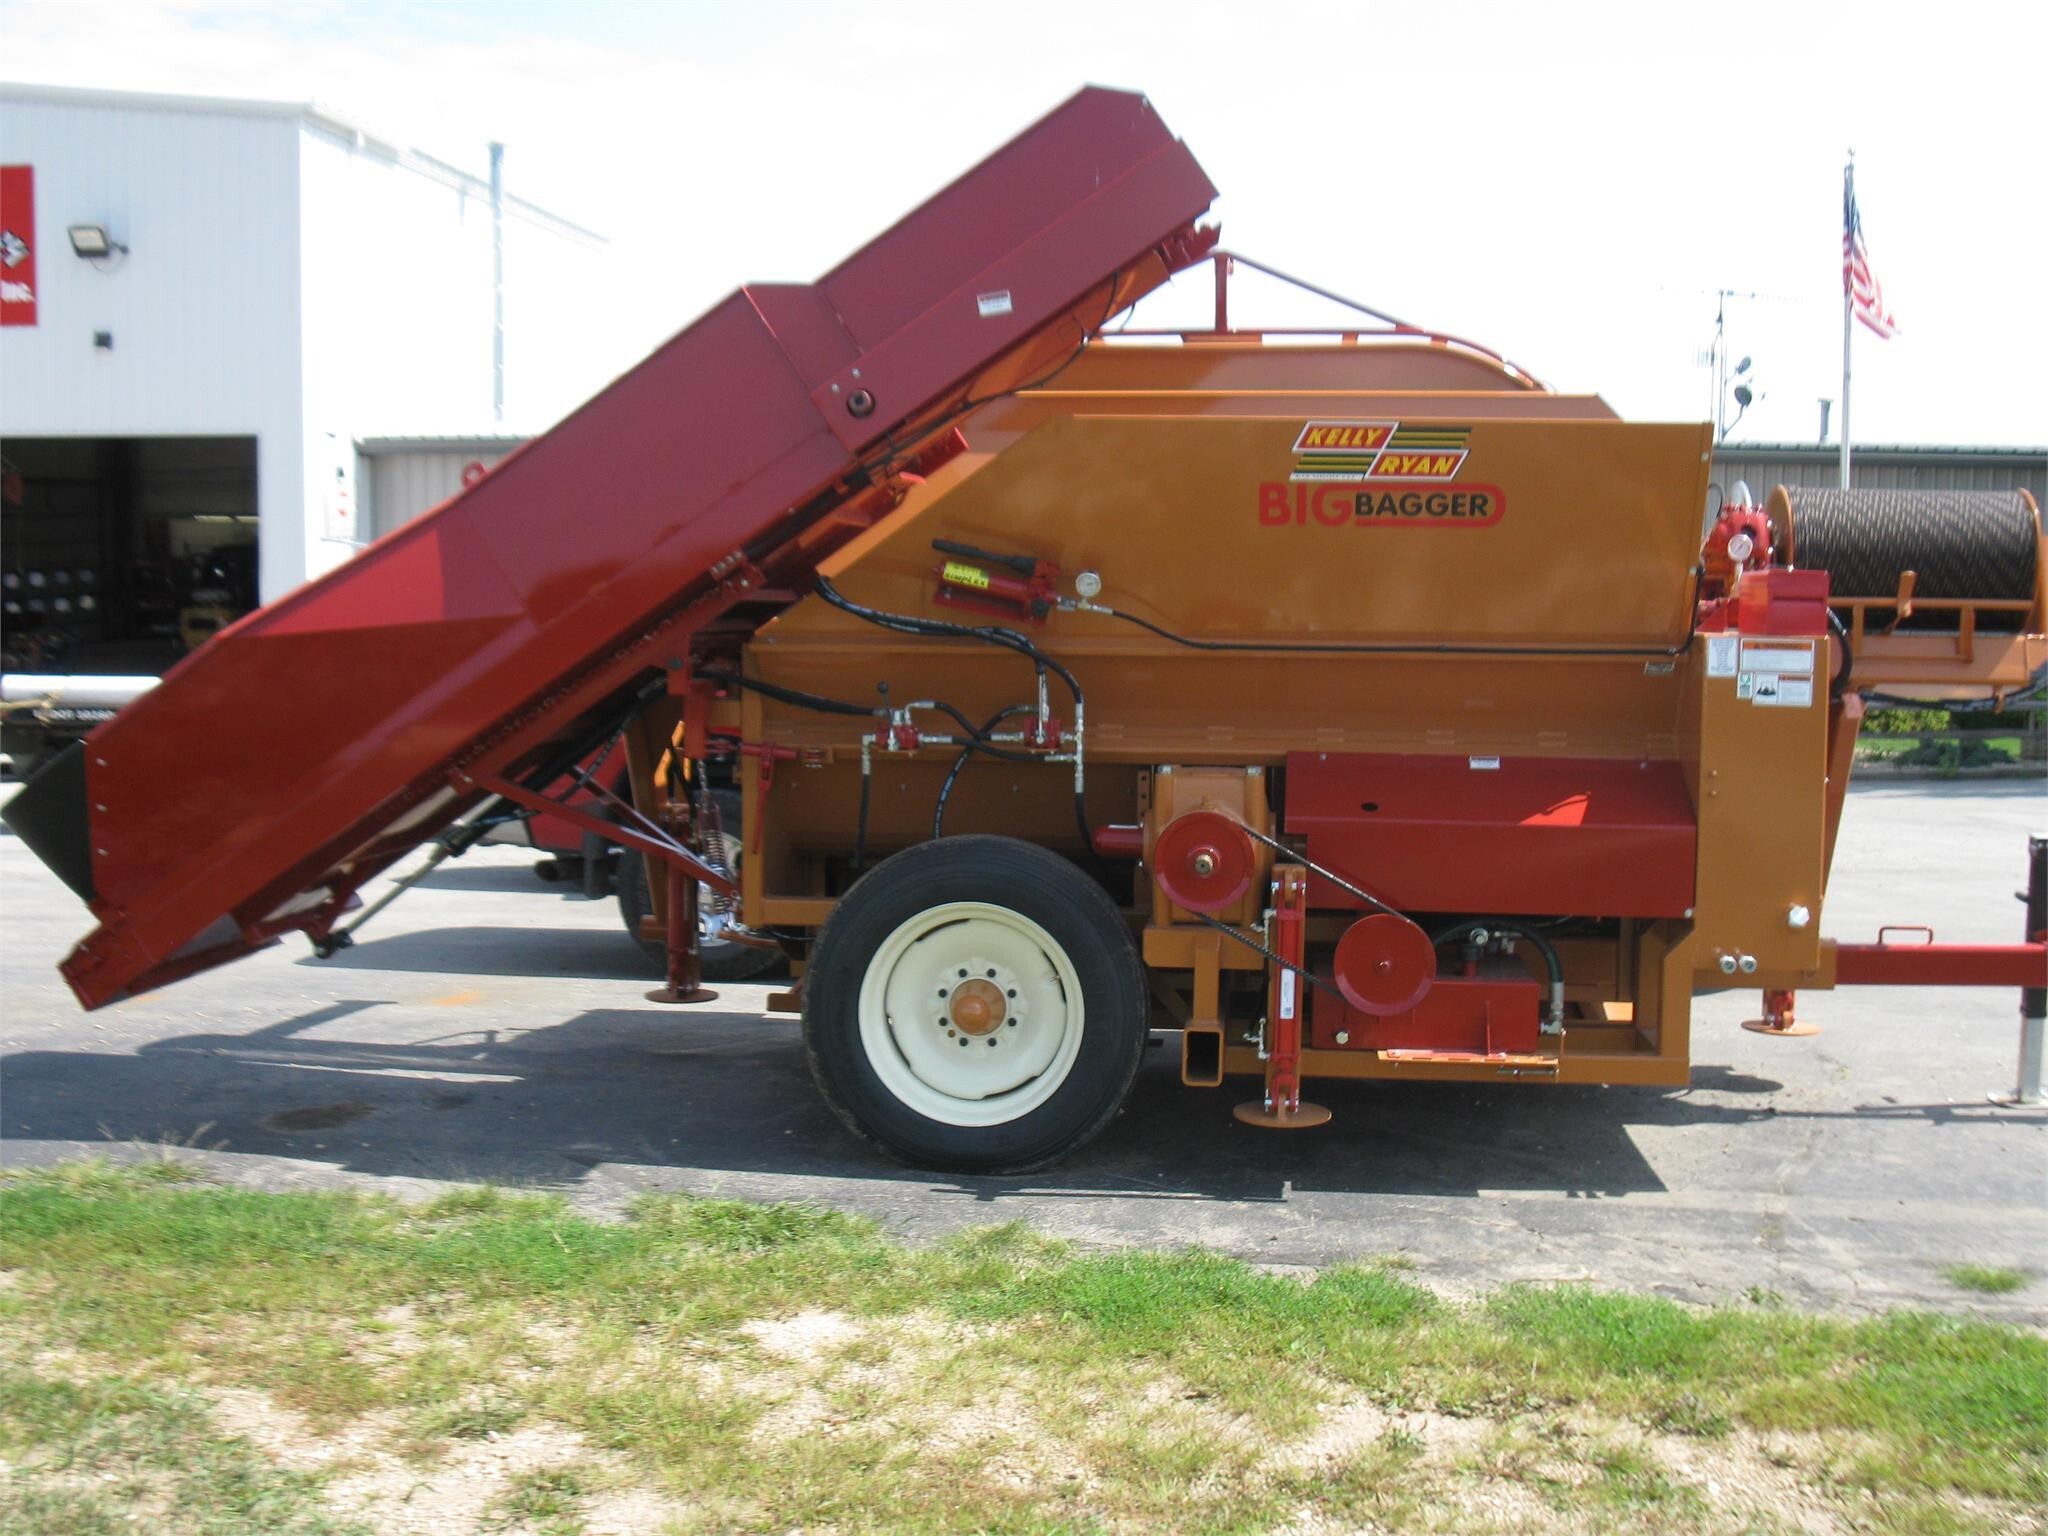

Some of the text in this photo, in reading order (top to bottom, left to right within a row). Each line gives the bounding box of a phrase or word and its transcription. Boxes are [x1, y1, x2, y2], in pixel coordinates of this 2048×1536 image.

[1305, 427, 1384, 447] KELLY
[1378, 455, 1456, 475] RYAN
[1259, 483, 1489, 527] BIG BAGGER
